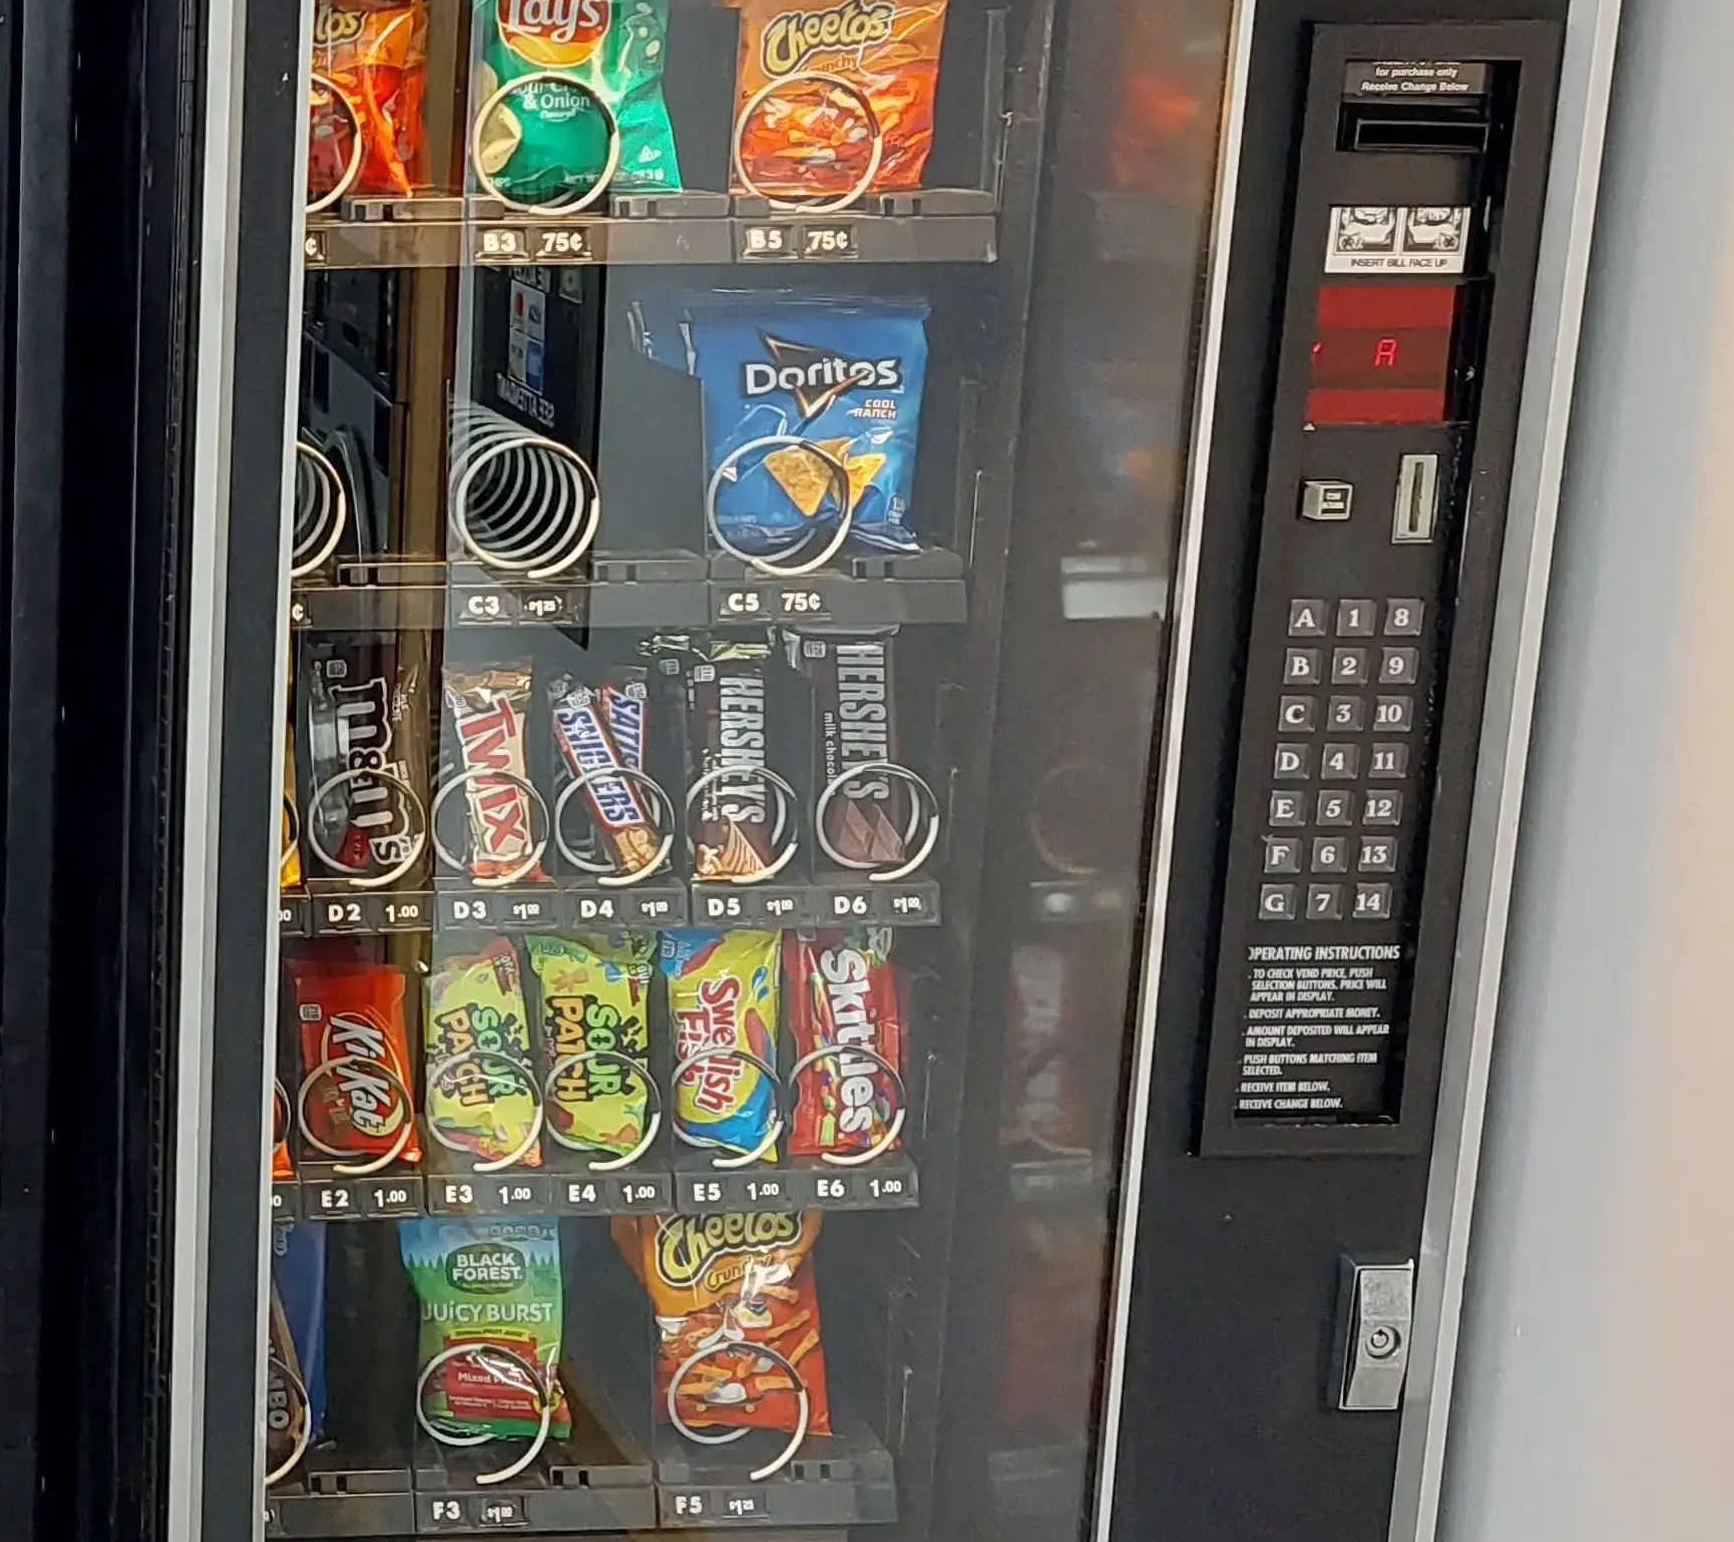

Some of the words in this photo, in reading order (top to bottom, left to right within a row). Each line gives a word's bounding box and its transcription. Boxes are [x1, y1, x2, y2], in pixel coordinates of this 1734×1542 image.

[766, 1, 889, 75] Cheetos
[1375, 68, 1389, 76] for
[1391, 68, 1434, 78] purchase
[1436, 68, 1458, 78] only
[1361, 83, 1398, 91] Receive
[1401, 83, 1437, 93] Change
[1439, 83, 1468, 91] Below
[540, 94, 590, 109] Onion
[483, 232, 516, 252] B3
[749, 230, 782, 249] B5
[744, 358, 899, 395] Doritos
[865, 399, 896, 409] COOL
[854, 408, 898, 420] RANCH
[468, 596, 500, 615] C3
[728, 593, 760, 612] C5
[1294, 610, 1316, 627] A
[1350, 609, 1360, 627] 1
[1394, 608, 1410, 626] 8
[1291, 657, 1310, 675] B
[1341, 657, 1357, 676] 2
[1389, 657, 1405, 674] 9
[1285, 705, 1306, 724] C
[1336, 705, 1352, 723] 3
[1377, 704, 1403, 723] 10
[824, 712, 836, 737] milk
[1279, 753, 1300, 772] D
[1329, 752, 1345, 771] 4
[1373, 752, 1395, 771] 11
[460, 698, 525, 853] TWIX
[1275, 800, 1295, 818] E
[1326, 799, 1342, 818] 5
[1366, 799, 1393, 817] 12
[1270, 845, 1291, 864] F
[1320, 845, 1336, 864] 6
[1362, 846, 1389, 864] 13
[454, 900, 487, 919] D3
[581, 899, 614, 918] D4
[708, 899, 741, 916] D5
[834, 896, 867, 914] D6
[1265, 894, 1285, 913] G
[1315, 894, 1332, 912] 7
[1356, 893, 1381, 911] 14
[328, 904, 361, 922] D2
[385, 905, 419, 922] 1.00
[1315, 945, 1401, 959] INSTRUCTIONS
[1253, 968, 1265, 979] TO
[1267, 968, 1294, 979] CHECK
[1296, 968, 1319, 978] VEND
[1349, 967, 1373, 978] PUSH
[1252, 980, 1295, 990] SELECTION
[1340, 979, 1365, 989] PRICE
[1367, 979, 1387, 989] WILL
[1250, 992, 1284, 1002] APPEAR
[1286, 991, 1295, 1001] IN
[1297, 991, 1335, 1001] DISPLAY.
[1249, 1008, 1284, 1019] DEPOSIT
[1285, 1008, 1343, 1019] APPROPRIATE
[1247, 1025, 1285, 1036] AMOUNT
[1287, 1025, 1332, 1035] DEPOSITED
[1334, 1025, 1354, 1035] WILL
[1356, 1025, 1389, 1035] APPEAR
[820, 948, 877, 1133] Skittles
[1246, 1037, 1255, 1047] IN
[1257, 1037, 1295, 1047] DISPLAY.
[1243, 1054, 1266, 1064] PUSH
[1269, 1054, 1307, 1064] BUTTONS
[1309, 1053, 1355, 1063] MATCHING
[1357, 1053, 1378, 1063] ITEM
[445, 1185, 473, 1203] E3
[499, 1187, 532, 1204] 1.00
[568, 1185, 596, 1202] E4
[623, 1185, 655, 1202] 1.00
[693, 1183, 721, 1201] E5
[747, 1183, 779, 1200] 1.00
[817, 1179, 845, 1196] E6
[869, 1180, 902, 1197] 1.00
[321, 1190, 350, 1208] E2
[374, 1190, 407, 1207] 1.00
[457, 1253, 516, 1267] BLACK
[487, 1302, 553, 1322] BURST
[433, 1502, 460, 1520] F3
[675, 1496, 703, 1514] F5
